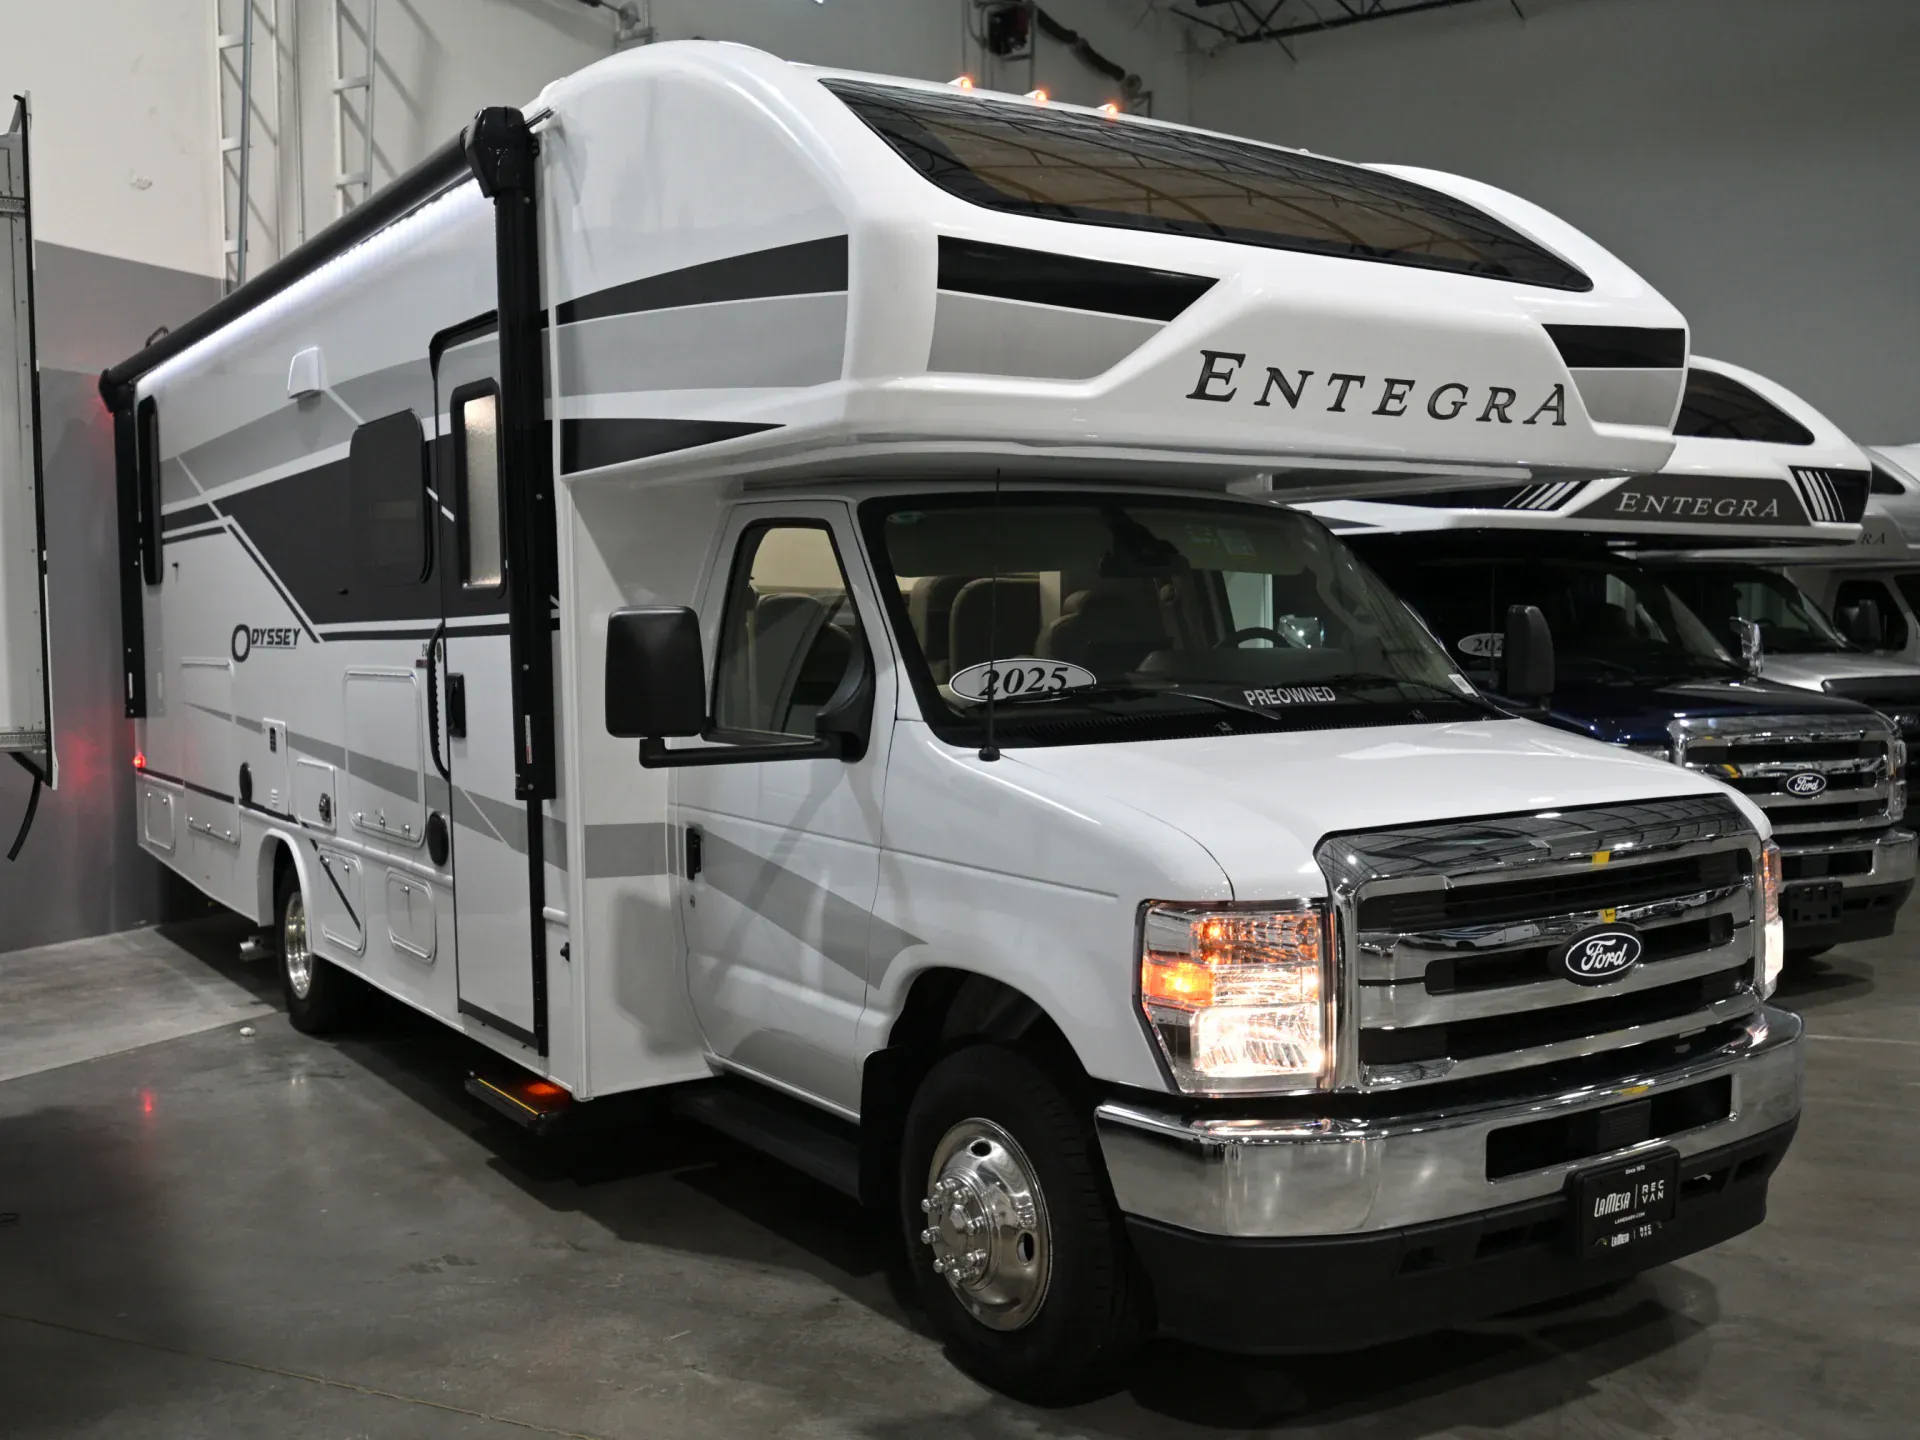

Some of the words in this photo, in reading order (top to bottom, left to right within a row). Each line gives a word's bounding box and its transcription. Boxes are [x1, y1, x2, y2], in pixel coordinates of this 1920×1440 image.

[1186, 349, 1567, 426] ENTEGRA
[1614, 491, 1780, 518] ENTEGRA
[231, 623, 301, 663] ODYSSEY
[977, 666, 1070, 697] 2025
[1242, 685, 1336, 706] PREOWNED
[1794, 774, 1820, 792] Ford
[1580, 938, 1628, 971] Ford
[1641, 1180, 1665, 1194] REC
[1641, 1190, 1665, 1204] VAN
